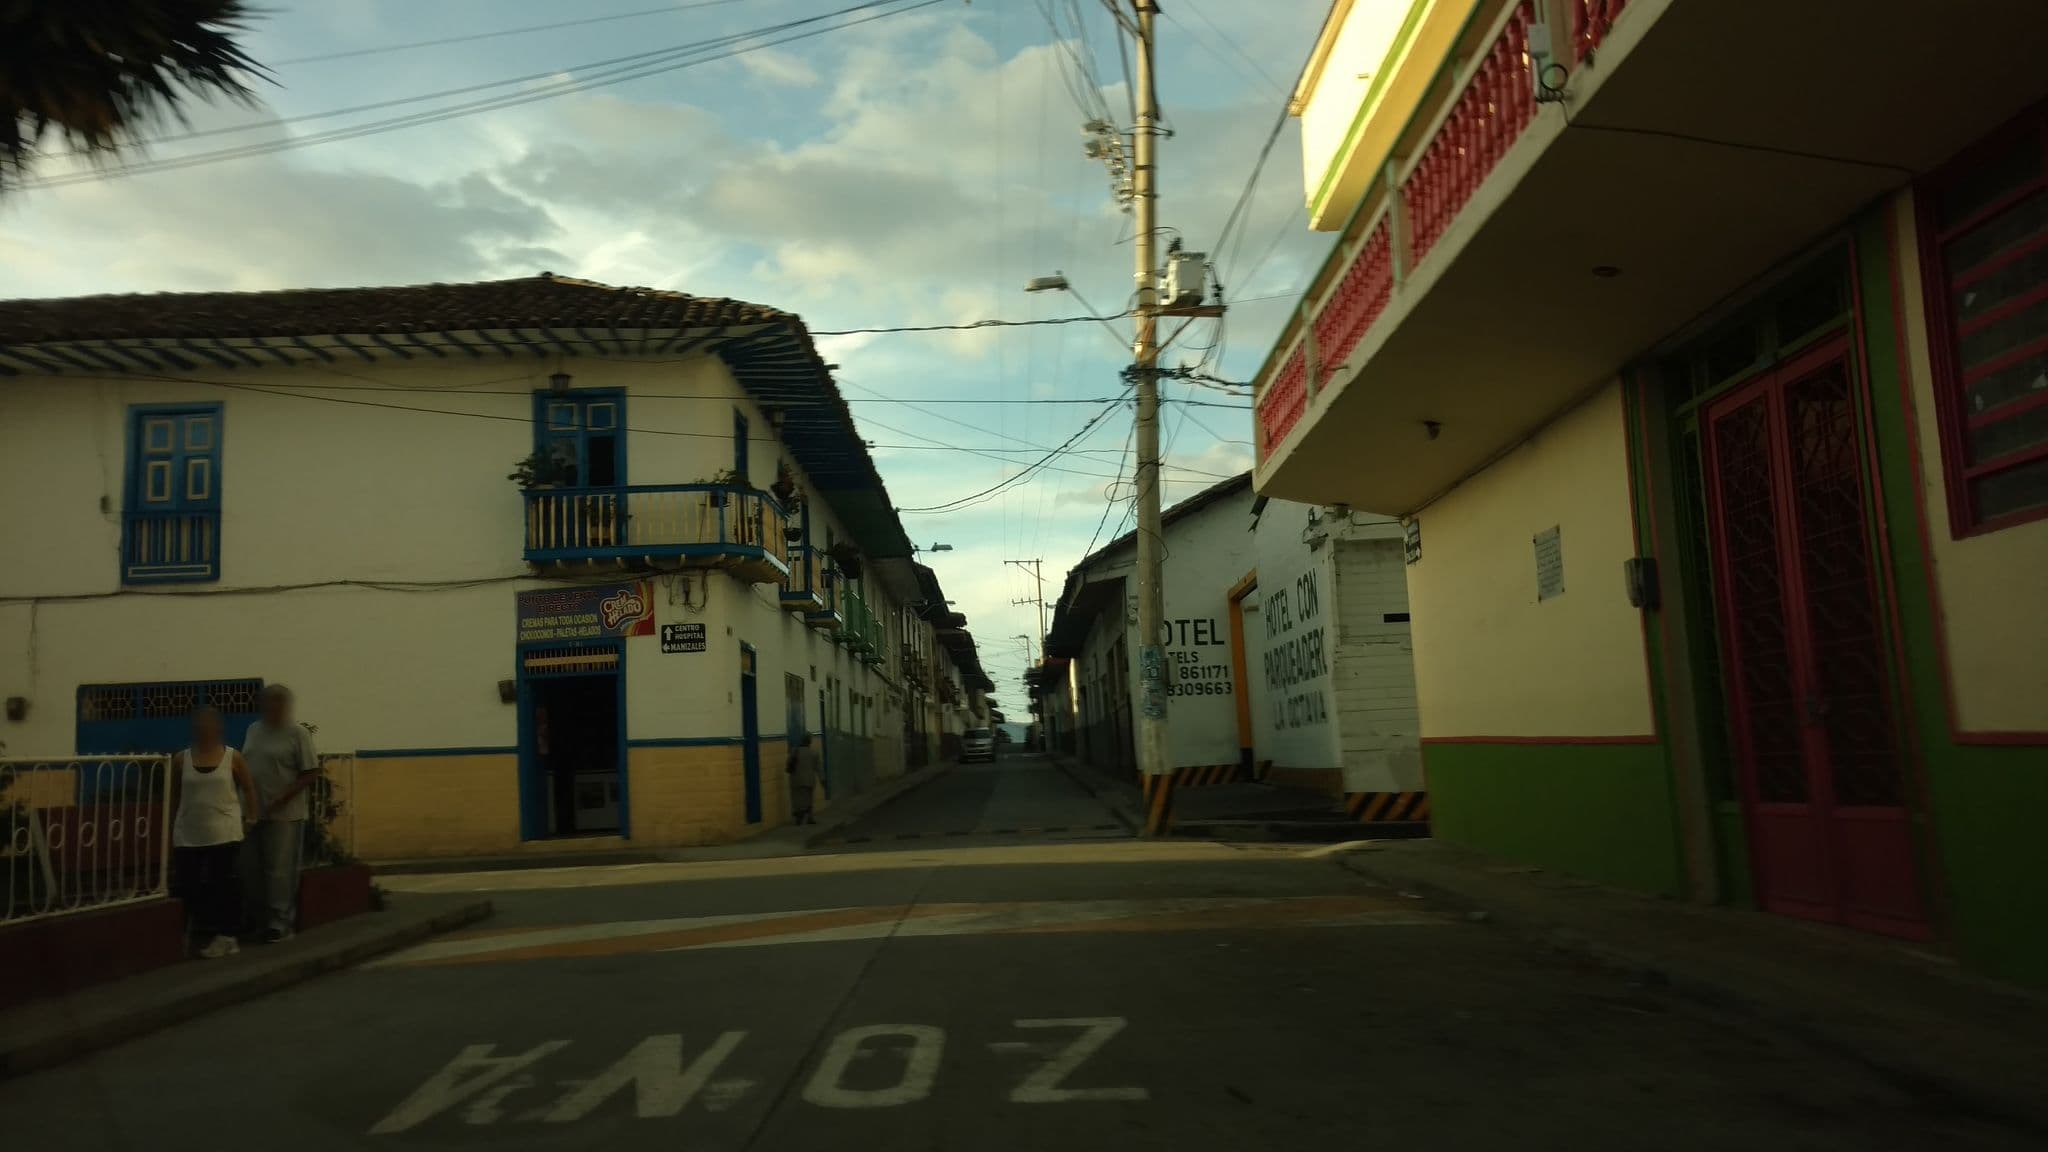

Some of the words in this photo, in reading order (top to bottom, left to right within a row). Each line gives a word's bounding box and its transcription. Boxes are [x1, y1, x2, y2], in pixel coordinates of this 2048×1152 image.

[603, 594, 627, 613] CREM
[608, 599, 642, 625] HELADO
[1265, 587, 1292, 640] HOTEL
[1296, 568, 1319, 623] CON
[522, 618, 543, 628] CREMAS
[544, 617, 558, 626] PARA
[559, 616, 573, 626] TODA
[674, 632, 705, 640] HOSPITAL
[1163, 618, 1225, 646] OTEL
[670, 642, 706, 652] MANIZALES
[1179, 664, 1228, 679] 861171
